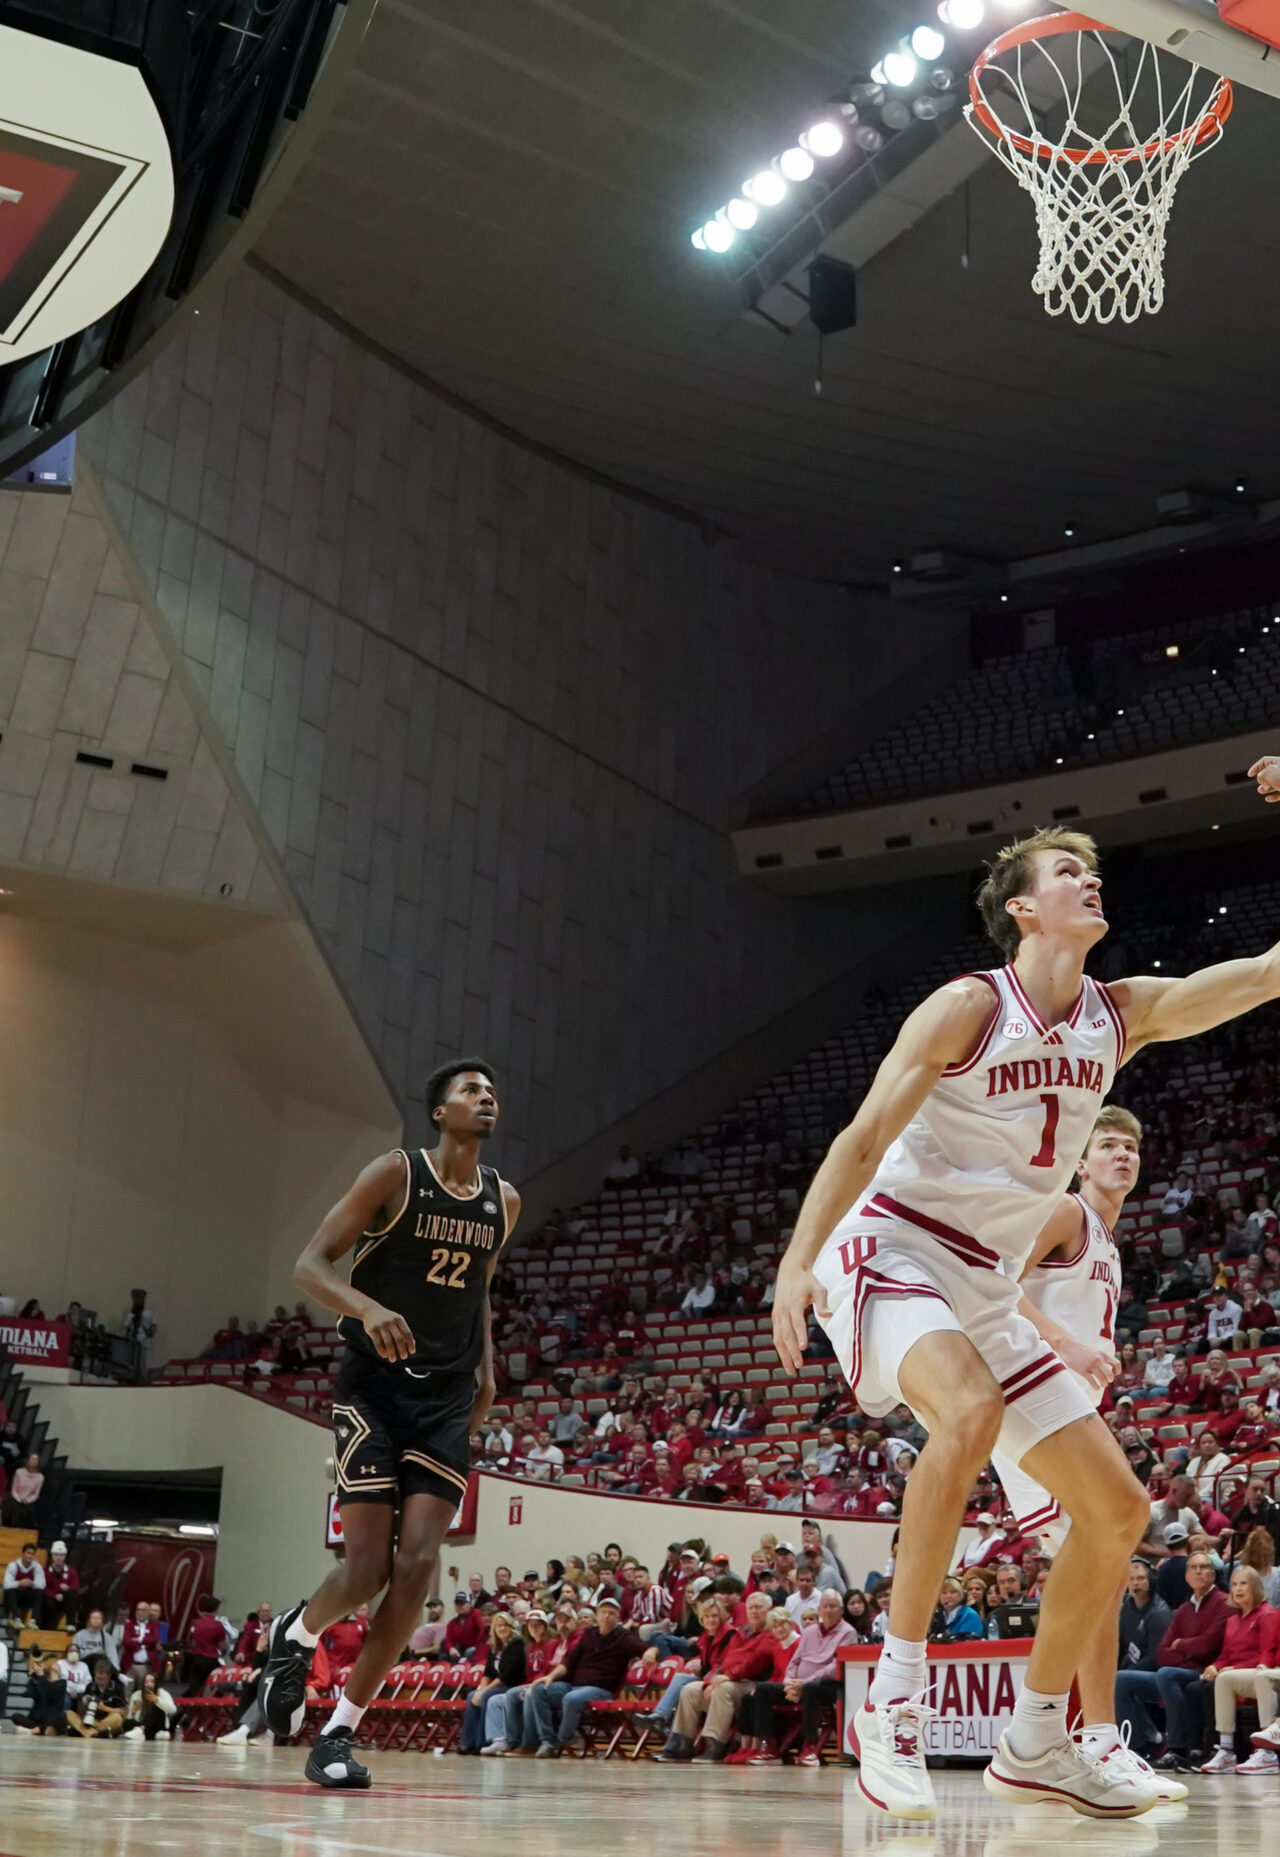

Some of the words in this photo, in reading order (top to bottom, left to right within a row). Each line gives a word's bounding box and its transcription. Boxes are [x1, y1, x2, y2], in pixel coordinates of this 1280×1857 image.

[986, 1057, 1104, 1098] INDIANA
[1029, 1093, 1060, 1168] 1
[414, 1212, 495, 1250] LINDENWOOD
[426, 1248, 472, 1289] 22
[1099, 1287, 1113, 1341] 1
